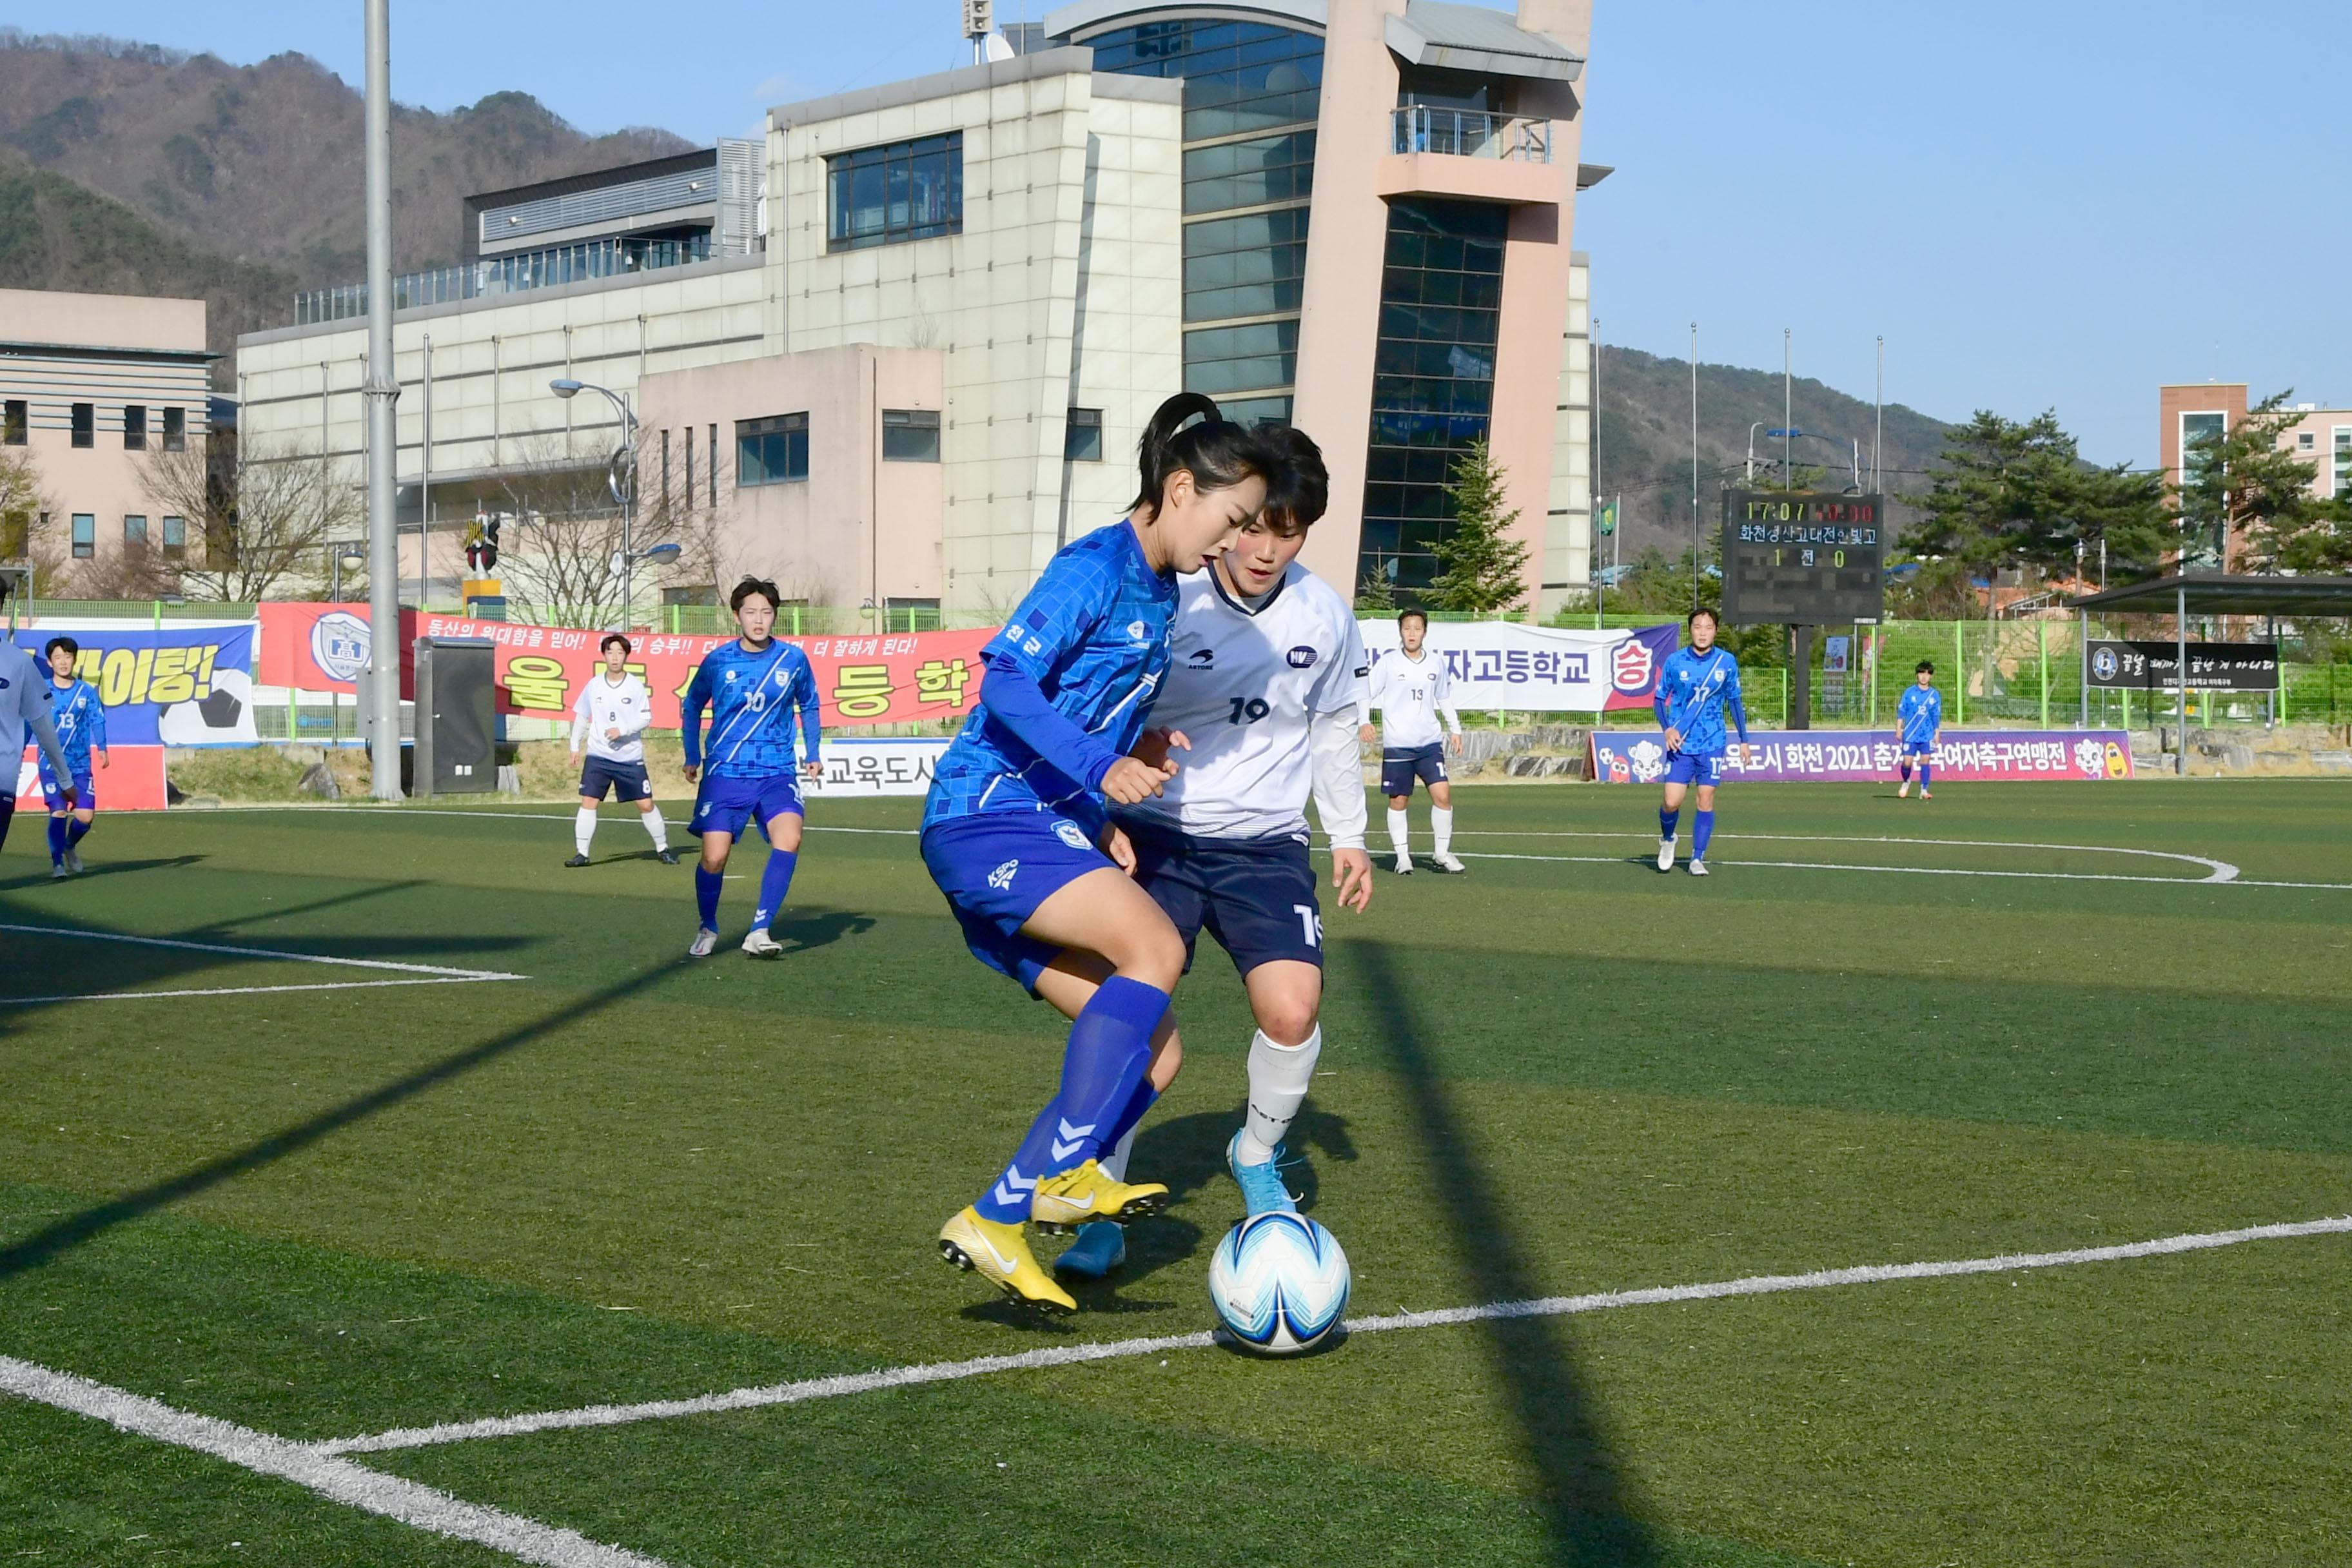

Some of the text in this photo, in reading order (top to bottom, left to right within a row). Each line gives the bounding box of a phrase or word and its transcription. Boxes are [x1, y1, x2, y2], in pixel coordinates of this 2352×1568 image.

[1774, 549, 1781, 567] 1
[1834, 550, 1845, 568] 0
[428, 619, 475, 638] 동산의
[480, 626, 544, 647] 위대함을
[551, 632, 587, 651] 믿어!
[649, 637, 693, 656] 승부!!
[701, 640, 719, 654] 더
[813, 640, 830, 658] 더
[833, 639, 879, 657] 잘하게
[882, 637, 919, 656] 된다!
[1365, 648, 1591, 685] 자고등학교
[1617, 645, 1647, 684] 승
[2235, 659, 2275, 671] 아니다
[502, 656, 569, 712] 울
[745, 691, 766, 712] 10
[1411, 689, 1424, 701] 13
[609, 711, 616, 721] 8
[1229, 696, 1270, 725] 19
[59, 714, 74, 729] 13
[1785, 743, 1824, 774] 화천
[1826, 745, 1873, 771] 2021
[1874, 741, 2067, 772] 춘국여자축구연맹전
[1436, 762, 1448, 778] 1
[642, 779, 651, 794] 8
[988, 859, 1019, 888] KSPO
